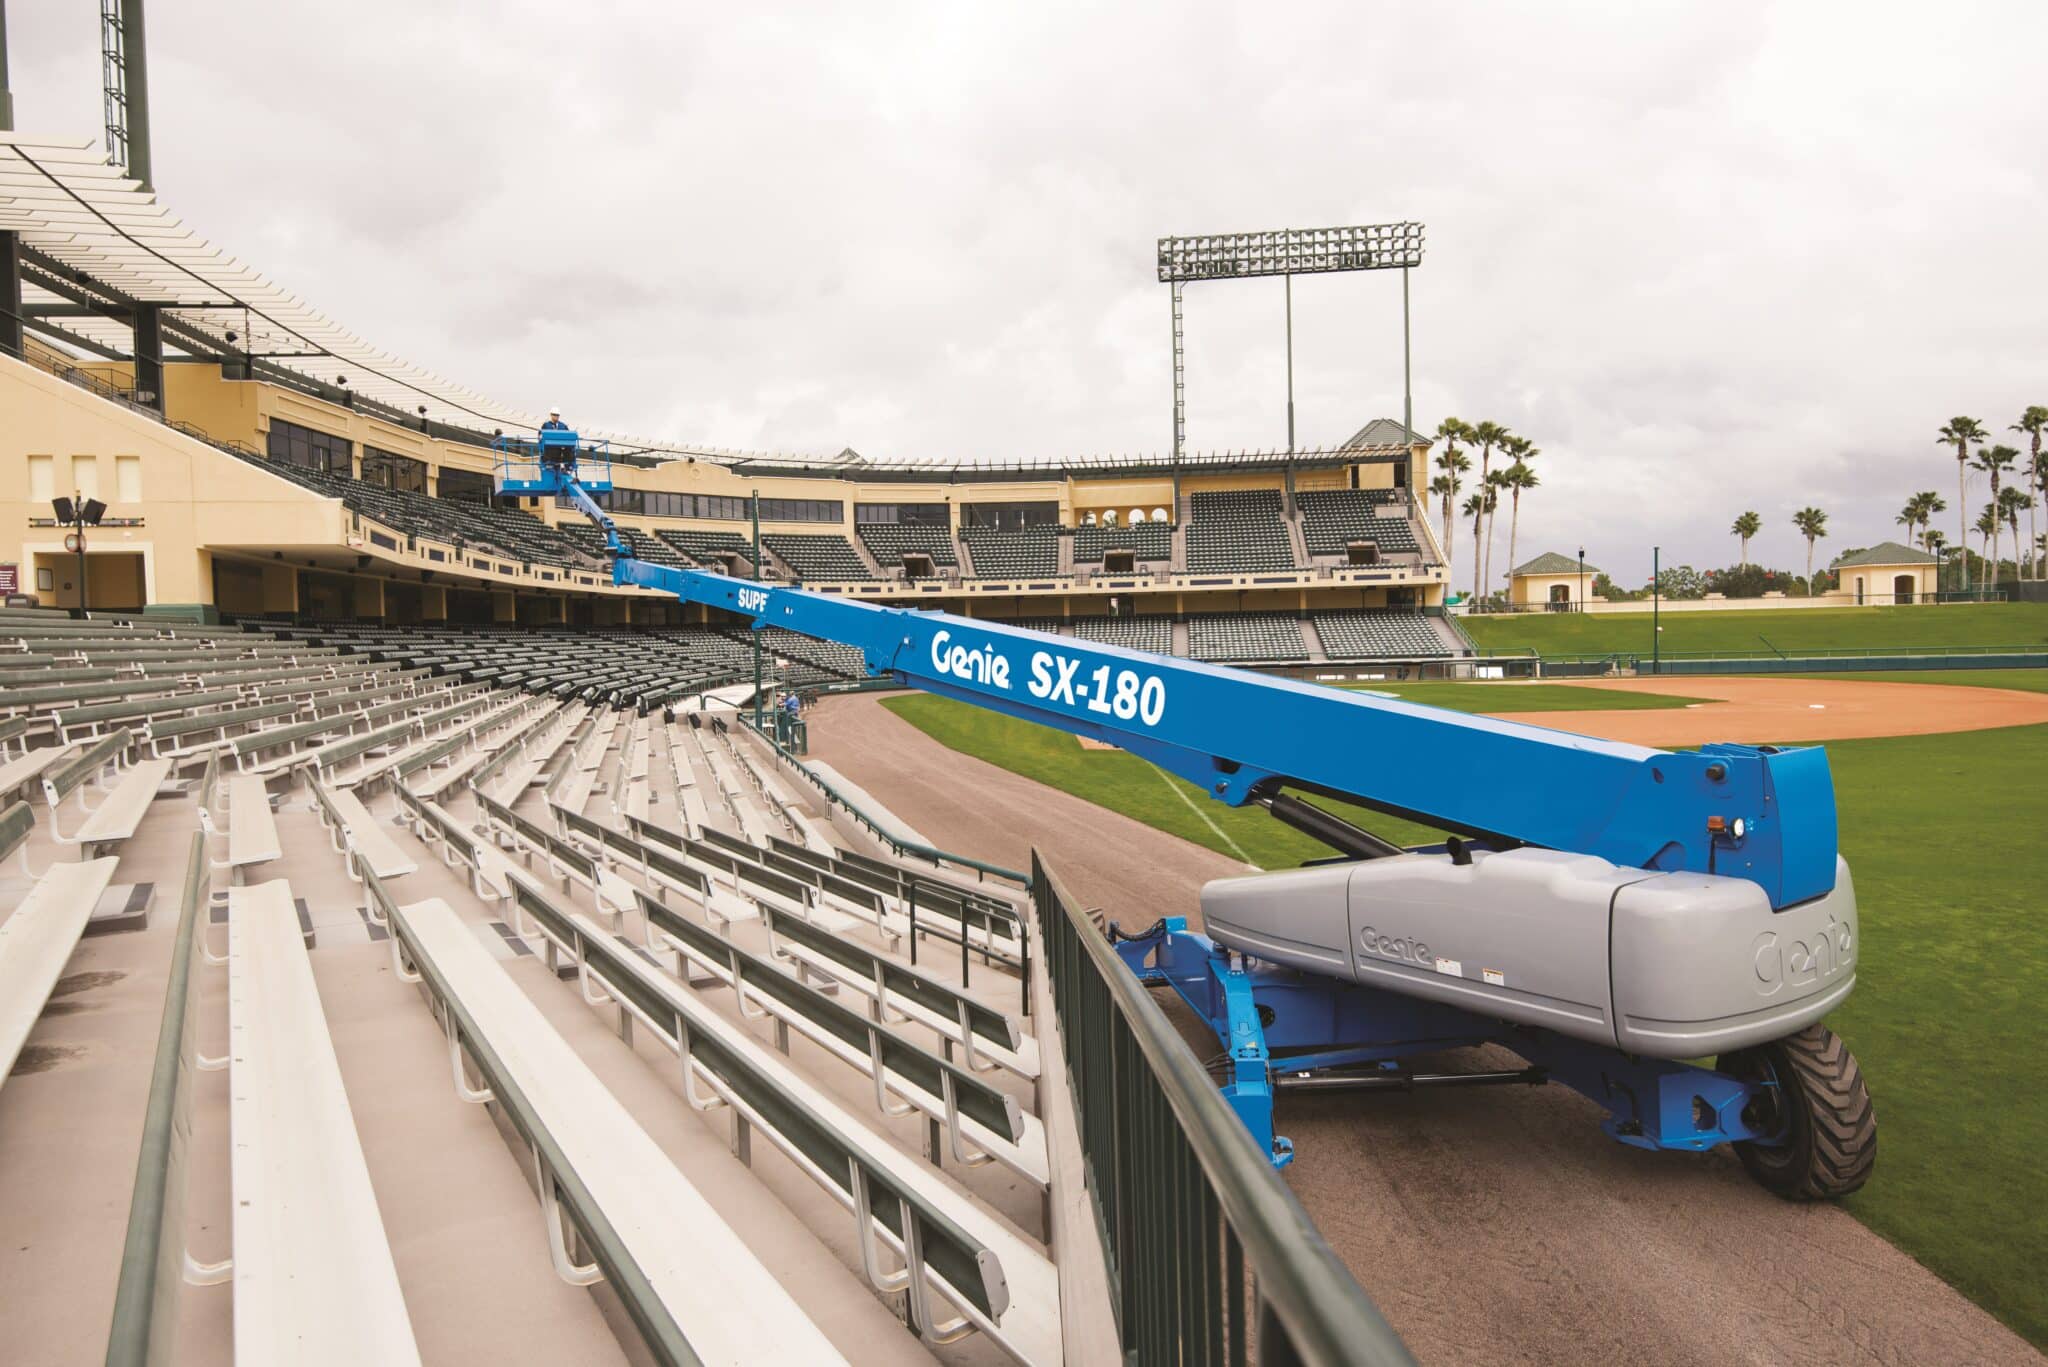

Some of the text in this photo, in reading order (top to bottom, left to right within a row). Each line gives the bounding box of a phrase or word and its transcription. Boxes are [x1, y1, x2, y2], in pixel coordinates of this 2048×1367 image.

[931, 629, 1166, 727] Genie SX-180
[1360, 926, 1433, 965] Genie
[1751, 912, 1852, 996] Genie
